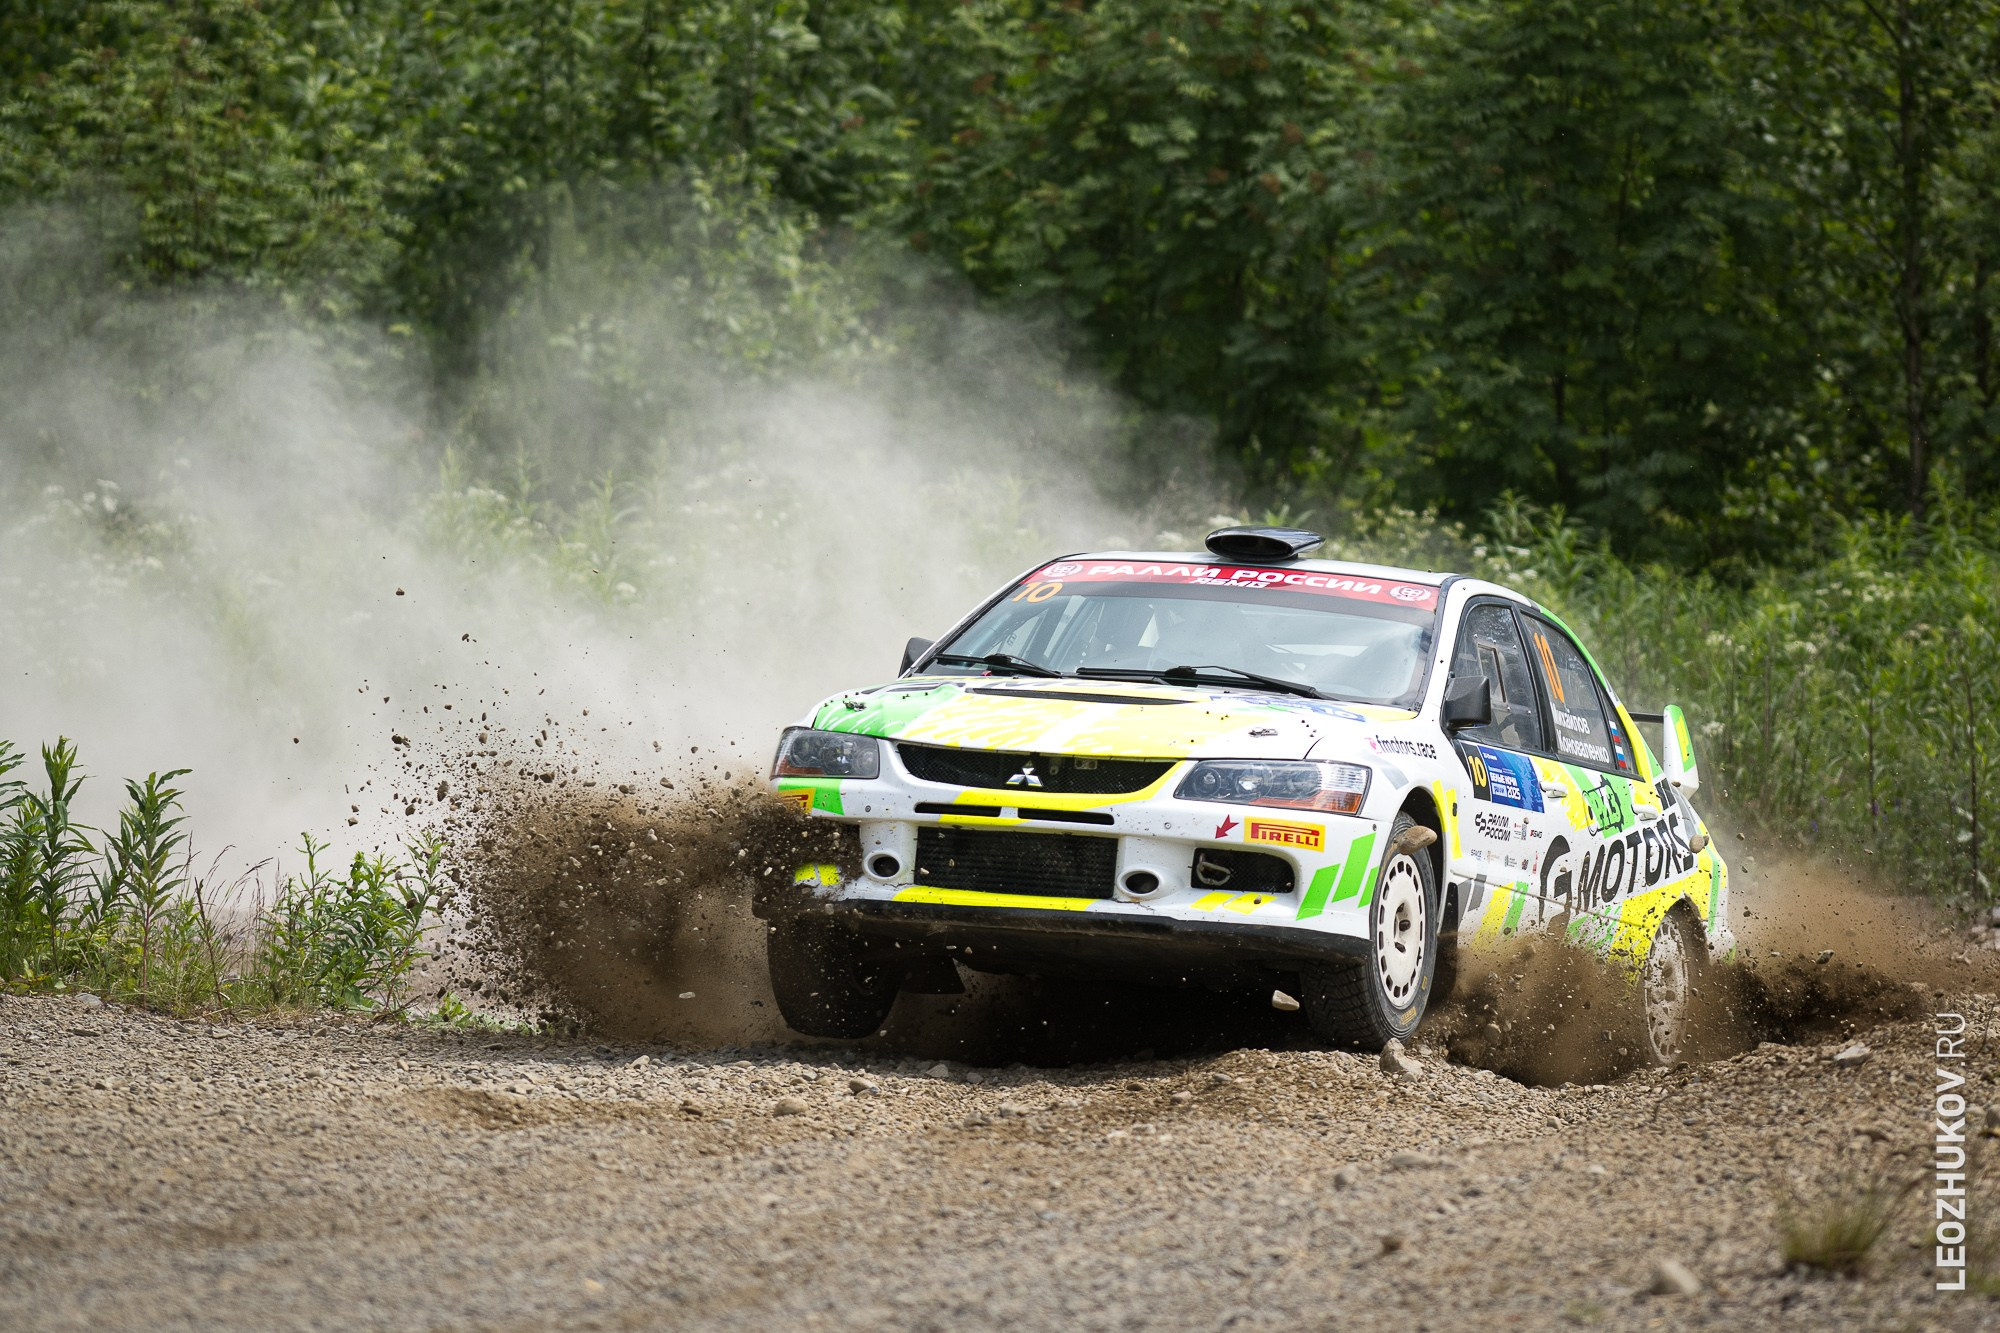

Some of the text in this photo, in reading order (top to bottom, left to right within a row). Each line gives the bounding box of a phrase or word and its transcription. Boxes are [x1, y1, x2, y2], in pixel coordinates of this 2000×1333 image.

[1011, 581, 1063, 604] 10
[1086, 564, 1382, 595] РАЛЛИ РОССИИ
[1534, 632, 1565, 704] 10
[1375, 734, 1437, 760] fmotors_race
[1467, 755, 1487, 788] 10
[1506, 785, 1521, 801] 2025
[1250, 822, 1320, 847] PIRELLI
[1575, 811, 1695, 917] MOTORS
